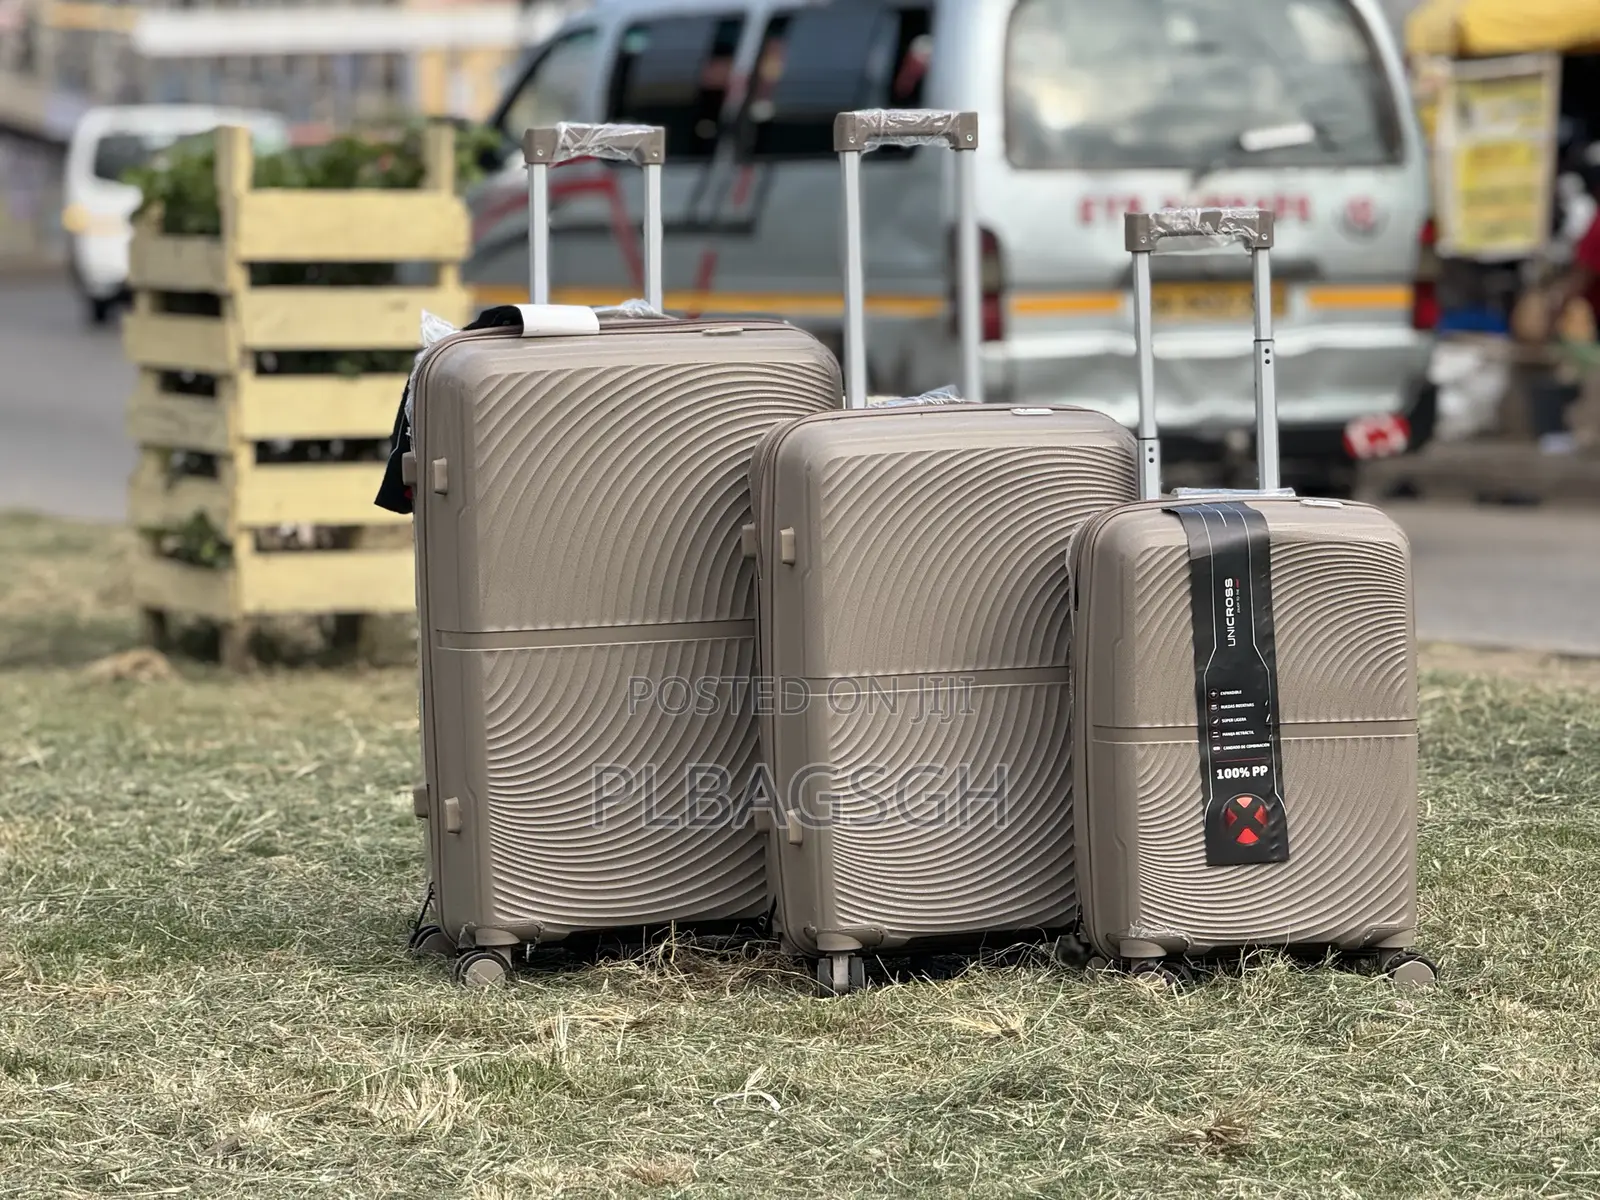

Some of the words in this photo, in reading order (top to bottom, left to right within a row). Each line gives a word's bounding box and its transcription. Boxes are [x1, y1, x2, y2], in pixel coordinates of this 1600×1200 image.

[1224, 578, 1236, 647] UNICROSS
[1216, 767, 1250, 780] 100%
[1252, 765, 1268, 777] PP
